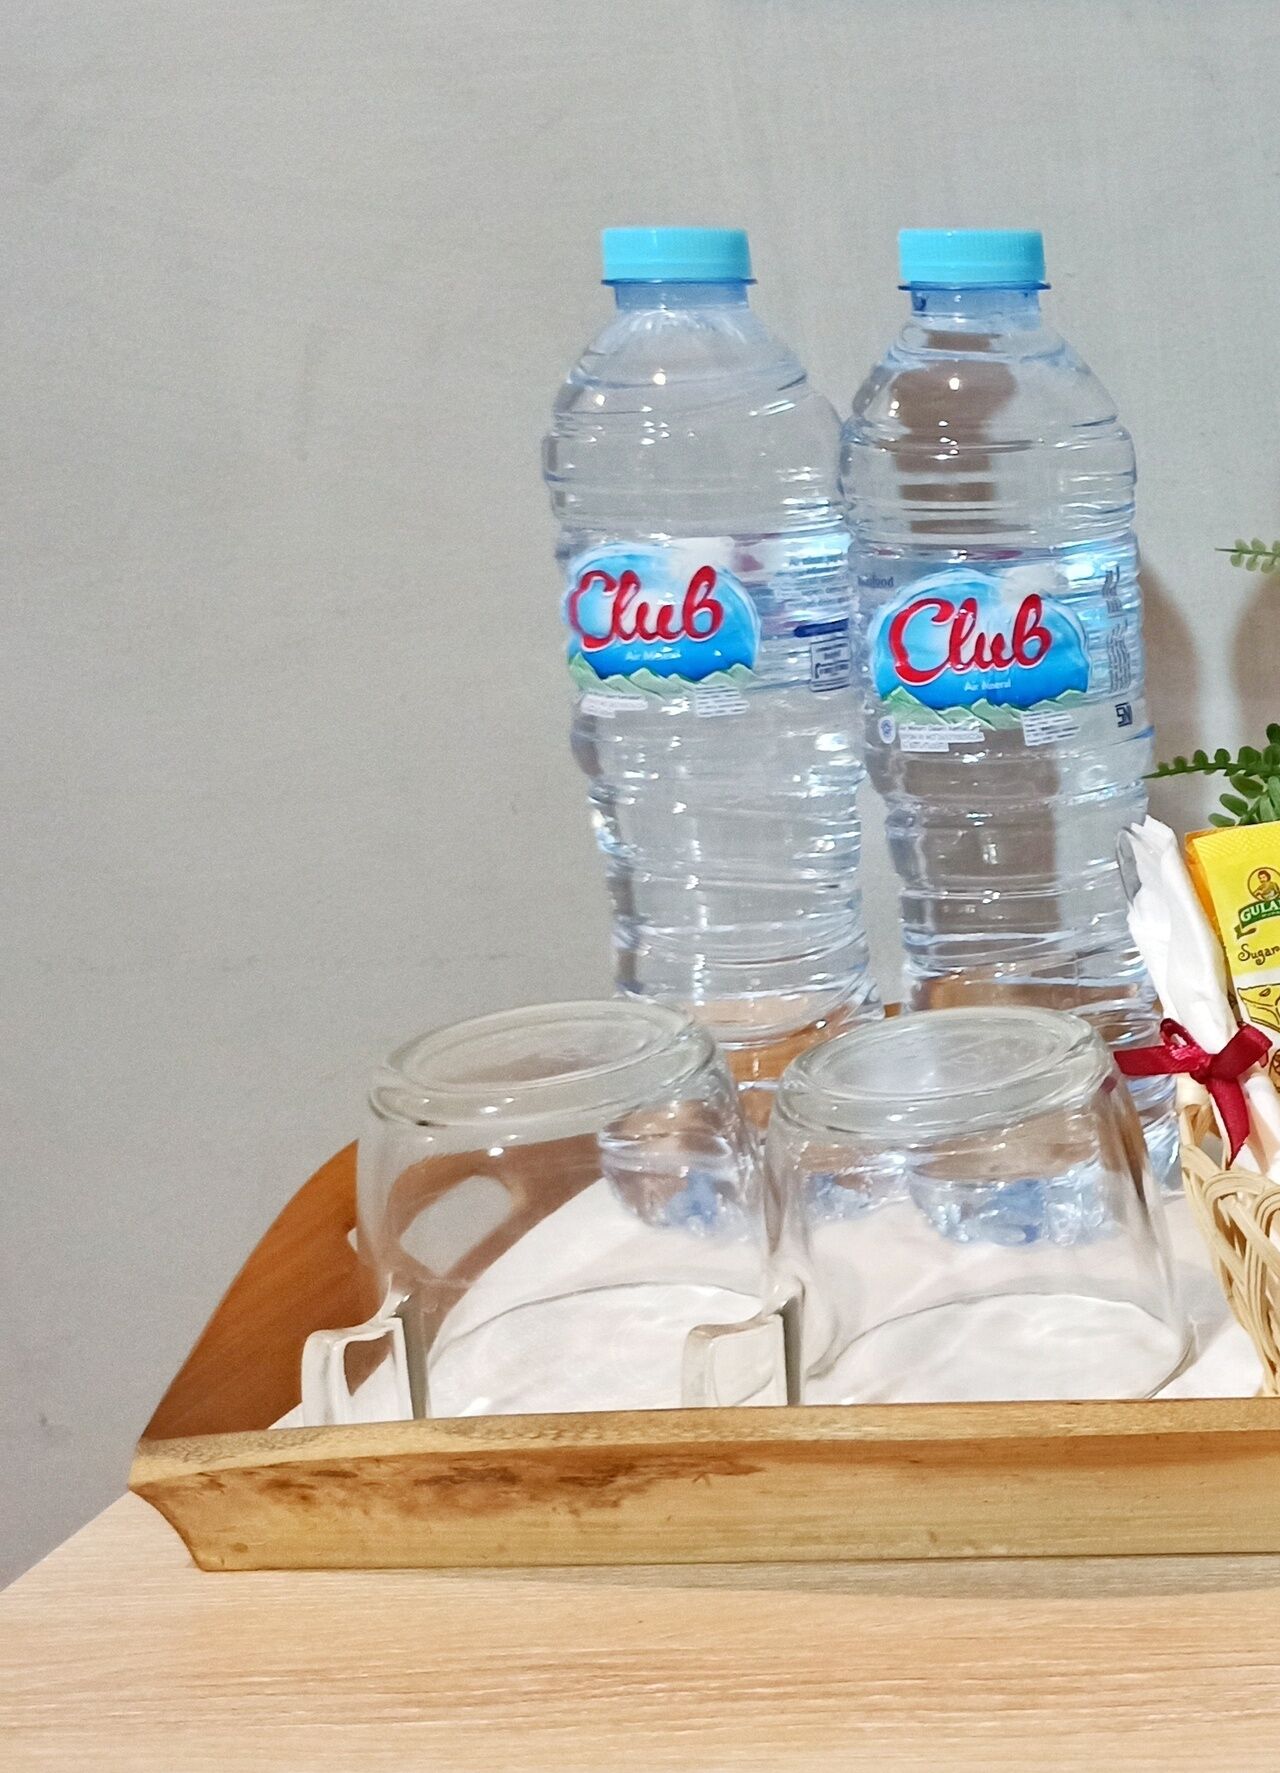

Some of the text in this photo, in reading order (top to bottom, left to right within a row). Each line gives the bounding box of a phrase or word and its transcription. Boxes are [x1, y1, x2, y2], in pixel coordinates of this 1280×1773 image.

[568, 565, 724, 650] Club
[888, 593, 1053, 684] Club
[1238, 943, 1280, 966] Sugar
